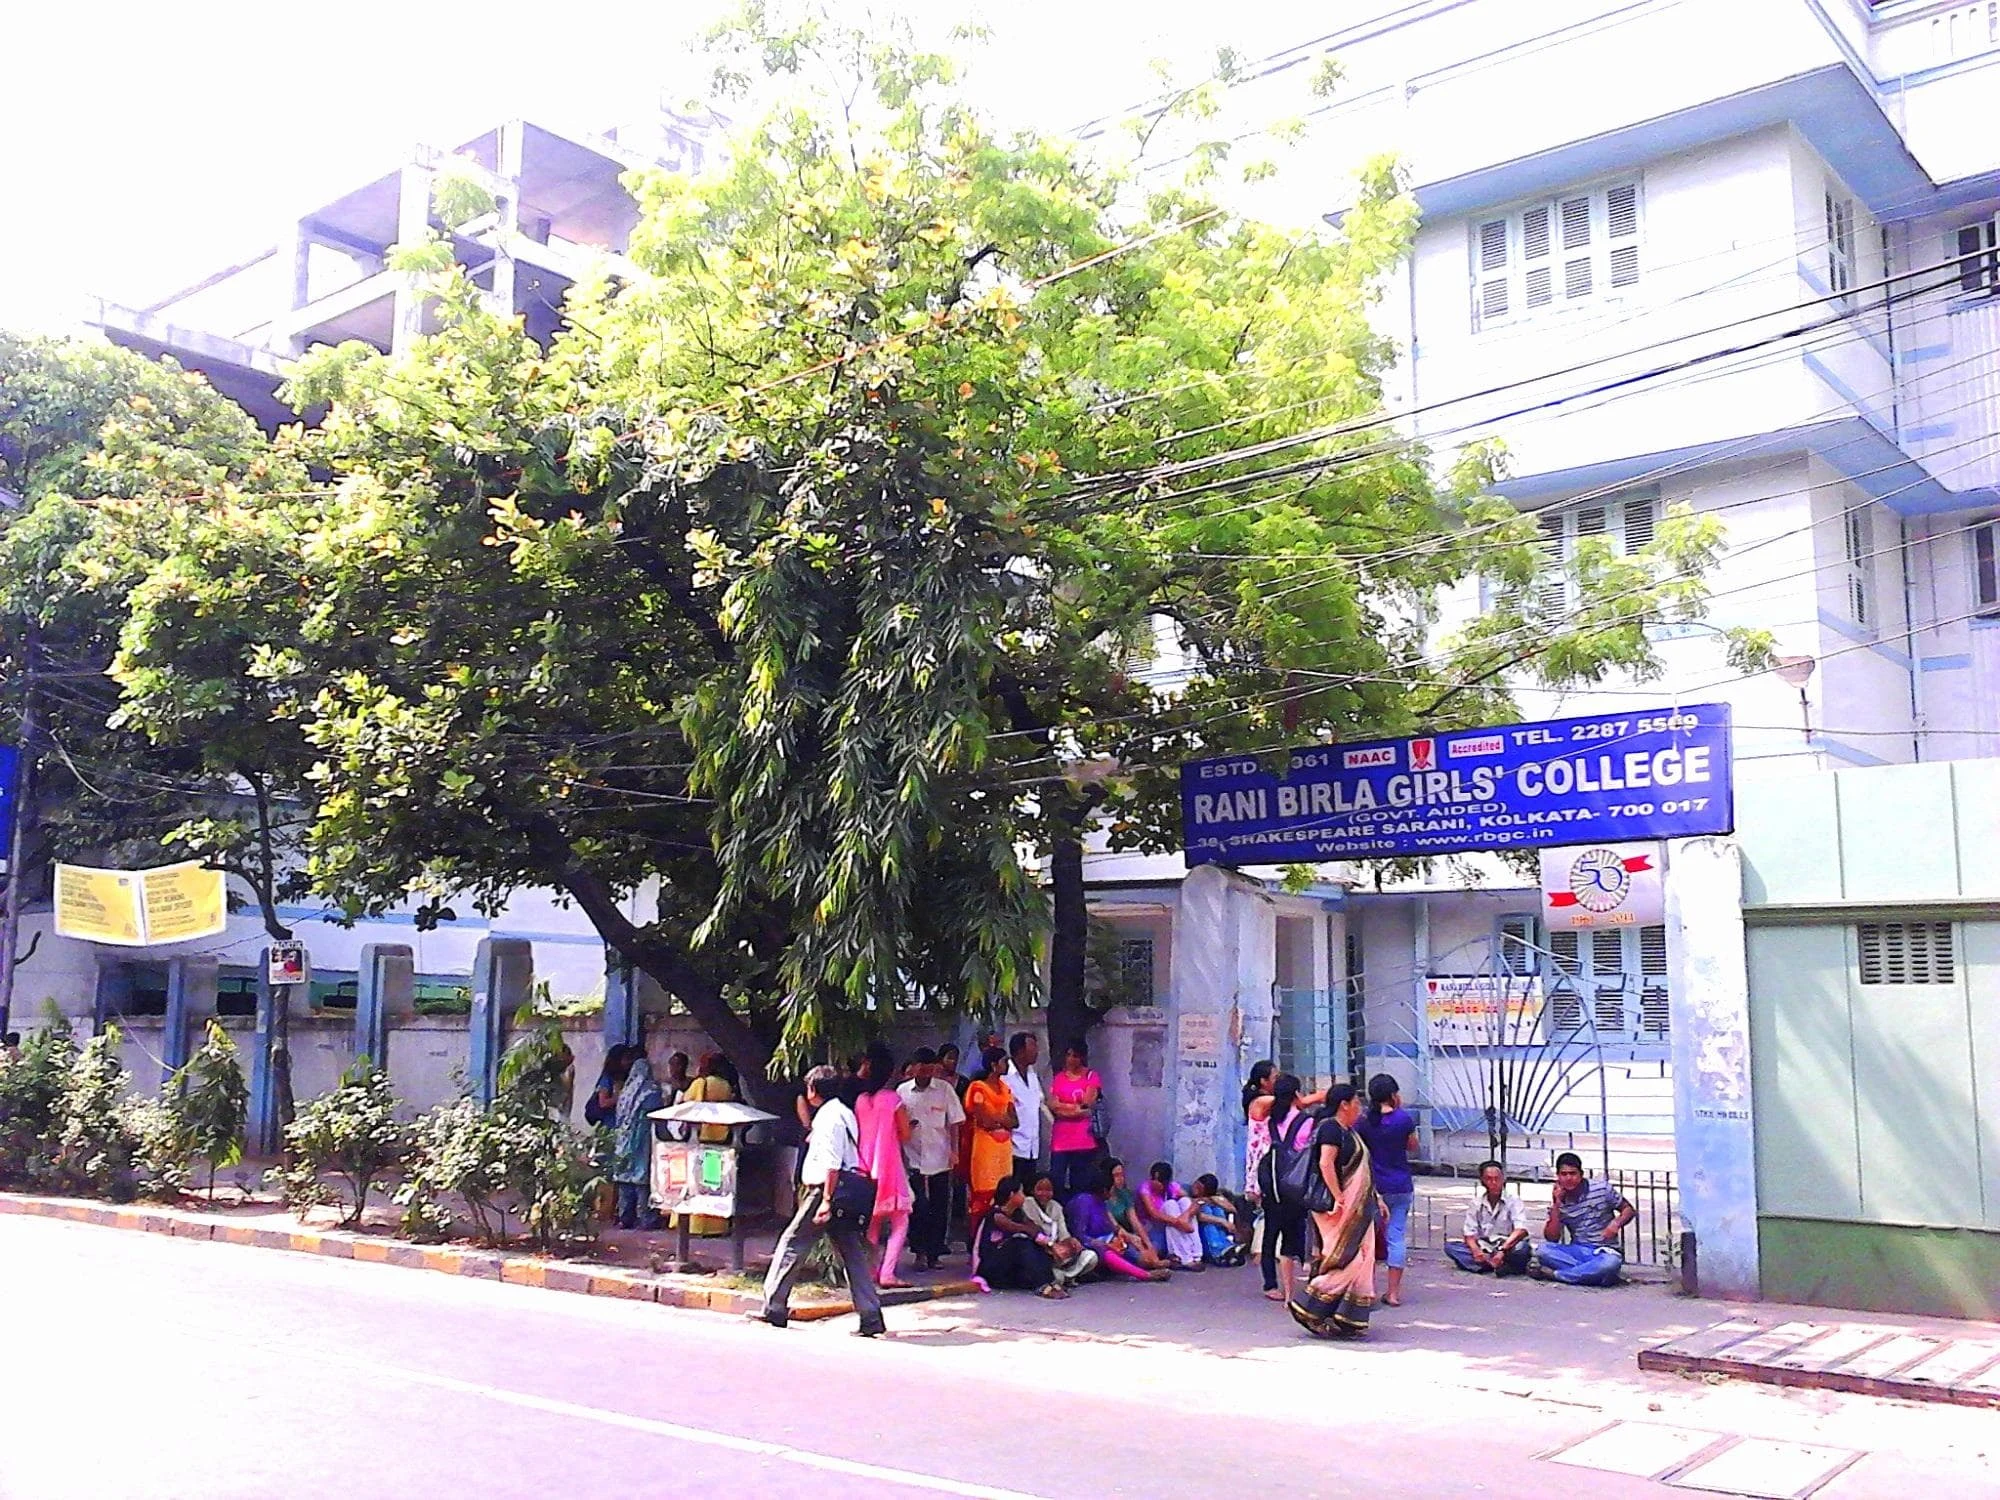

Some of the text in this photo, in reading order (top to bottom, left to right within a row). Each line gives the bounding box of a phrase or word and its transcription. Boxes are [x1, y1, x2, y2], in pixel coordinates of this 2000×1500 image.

[1511, 729, 1564, 747] TEL.
[1571, 721, 1630, 742] 2287
[1347, 750, 1392, 765] NAAC
[1451, 740, 1501, 755] Accredited
[1200, 761, 1264, 779] ESTD.
[1194, 745, 1711, 825] RANI BIRLA GIRLS' COLLEGE
[1230, 824, 1376, 846] SHAKESPEARE
[1381, 818, 1473, 836] SARANI,
[1607, 803, 1656, 818] 700
[1661, 797, 1710, 815] 017
[1348, 802, 1508, 825] (GOVT. AIDED)
[1315, 838, 1396, 854] Website
[1415, 827, 1554, 847] www.rbgc.in
[1579, 860, 1623, 893] 50
